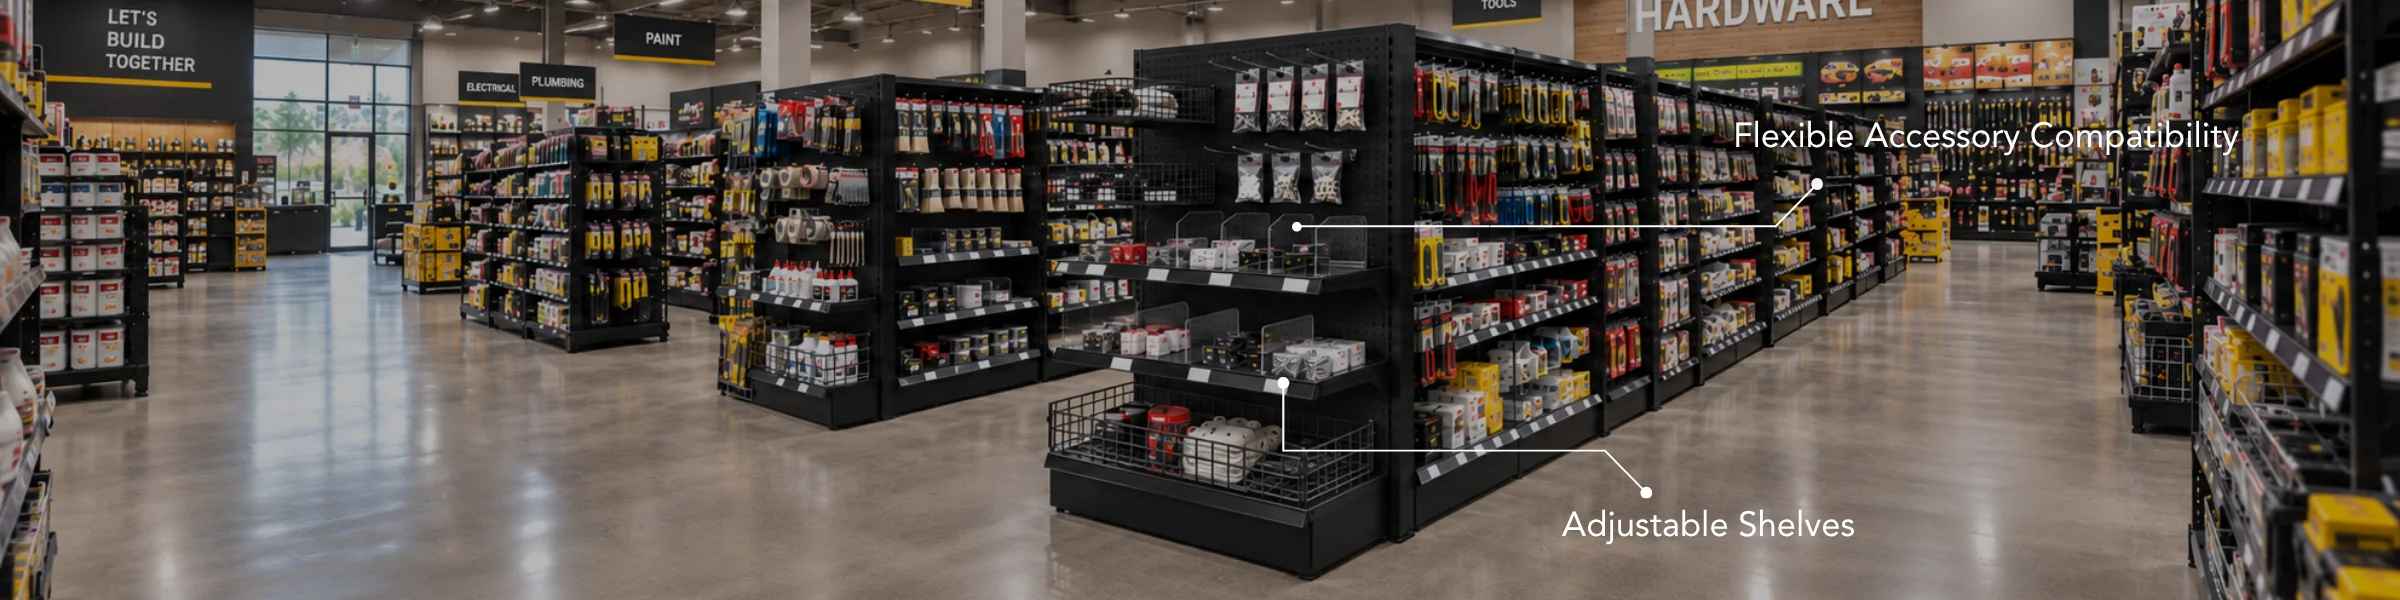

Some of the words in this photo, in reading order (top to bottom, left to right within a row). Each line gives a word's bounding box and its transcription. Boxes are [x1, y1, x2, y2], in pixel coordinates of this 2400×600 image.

[1480, 0, 1518, 10] TOOLS
[107, 8, 158, 27] LET'S
[106, 31, 166, 50] BUILD
[645, 31, 682, 47] PAINT
[105, 53, 196, 73] TOGETHER
[466, 82, 517, 94] ELECTRICAL
[531, 75, 585, 89] PLUMBING
